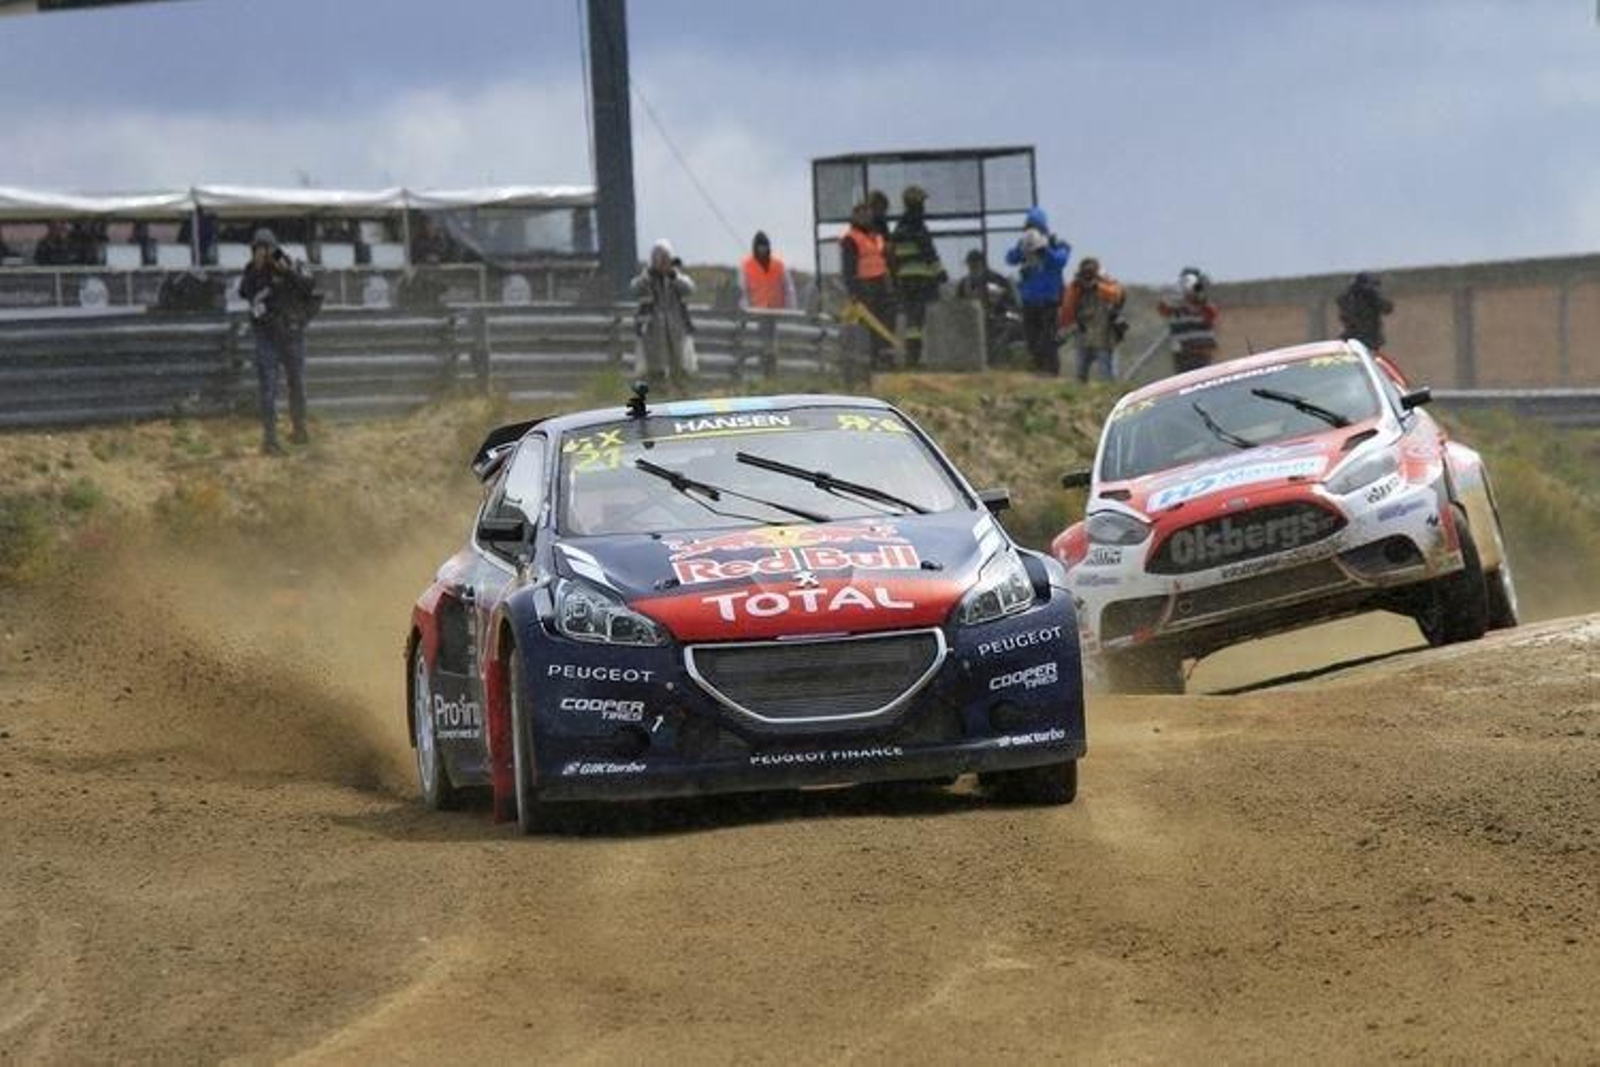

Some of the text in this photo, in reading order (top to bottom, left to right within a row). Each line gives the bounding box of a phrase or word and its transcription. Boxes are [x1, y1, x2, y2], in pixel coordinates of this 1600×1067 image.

[674, 413, 791, 434] HANSEN
[1168, 510, 1319, 565] Olsbergs
[671, 545, 922, 585] Red Bull
[701, 585, 915, 621] TOTAL
[976, 626, 1063, 657] PEUGEOT
[547, 664, 654, 684] PEUGEOT
[988, 662, 1058, 691] COOPER
[559, 697, 645, 712] COOPER
[600, 710, 643, 722] TIRES
[750, 746, 903, 765] PEUGEOT FINANCE
